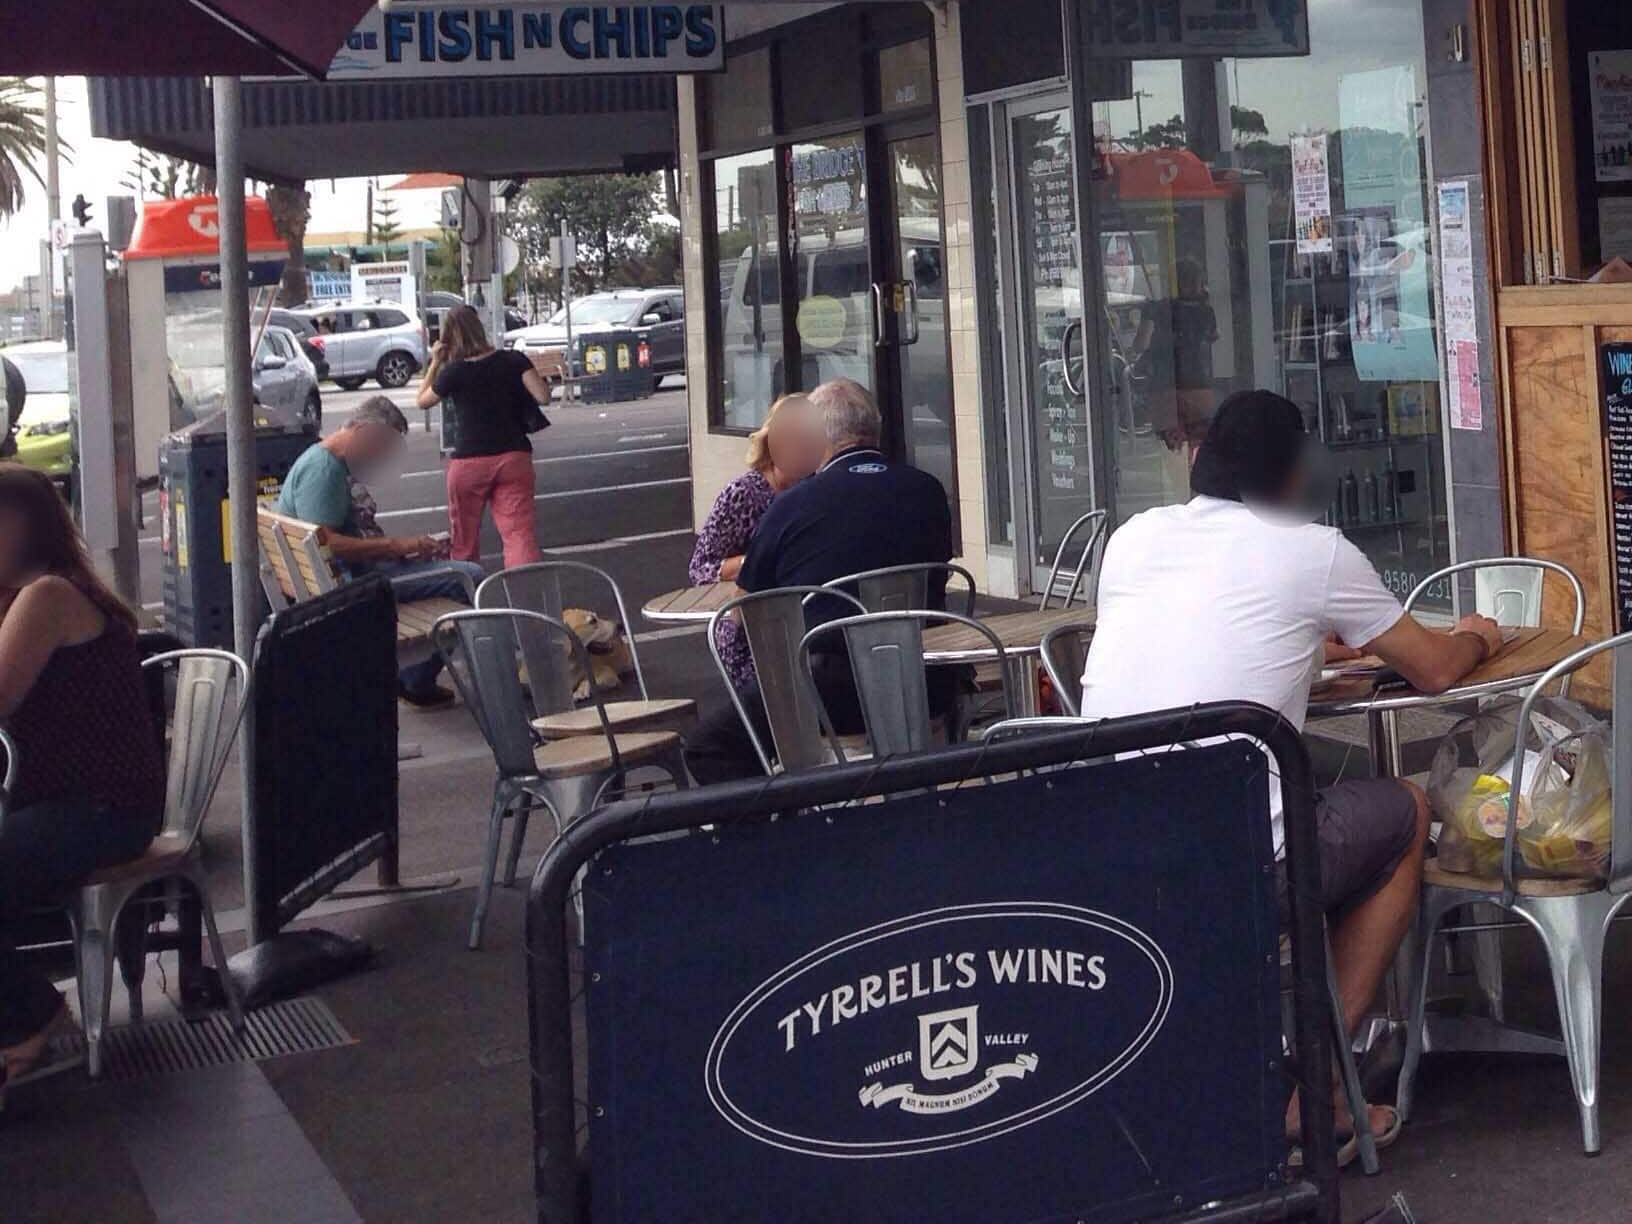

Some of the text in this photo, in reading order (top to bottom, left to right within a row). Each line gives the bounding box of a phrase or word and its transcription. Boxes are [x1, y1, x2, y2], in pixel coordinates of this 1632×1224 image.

[383, 4, 716, 62] FISH N CHIPS
[777, 948, 1106, 1052] TYRRELL'S WINES
[864, 1034, 1029, 1077] HUNTER VALLEY
